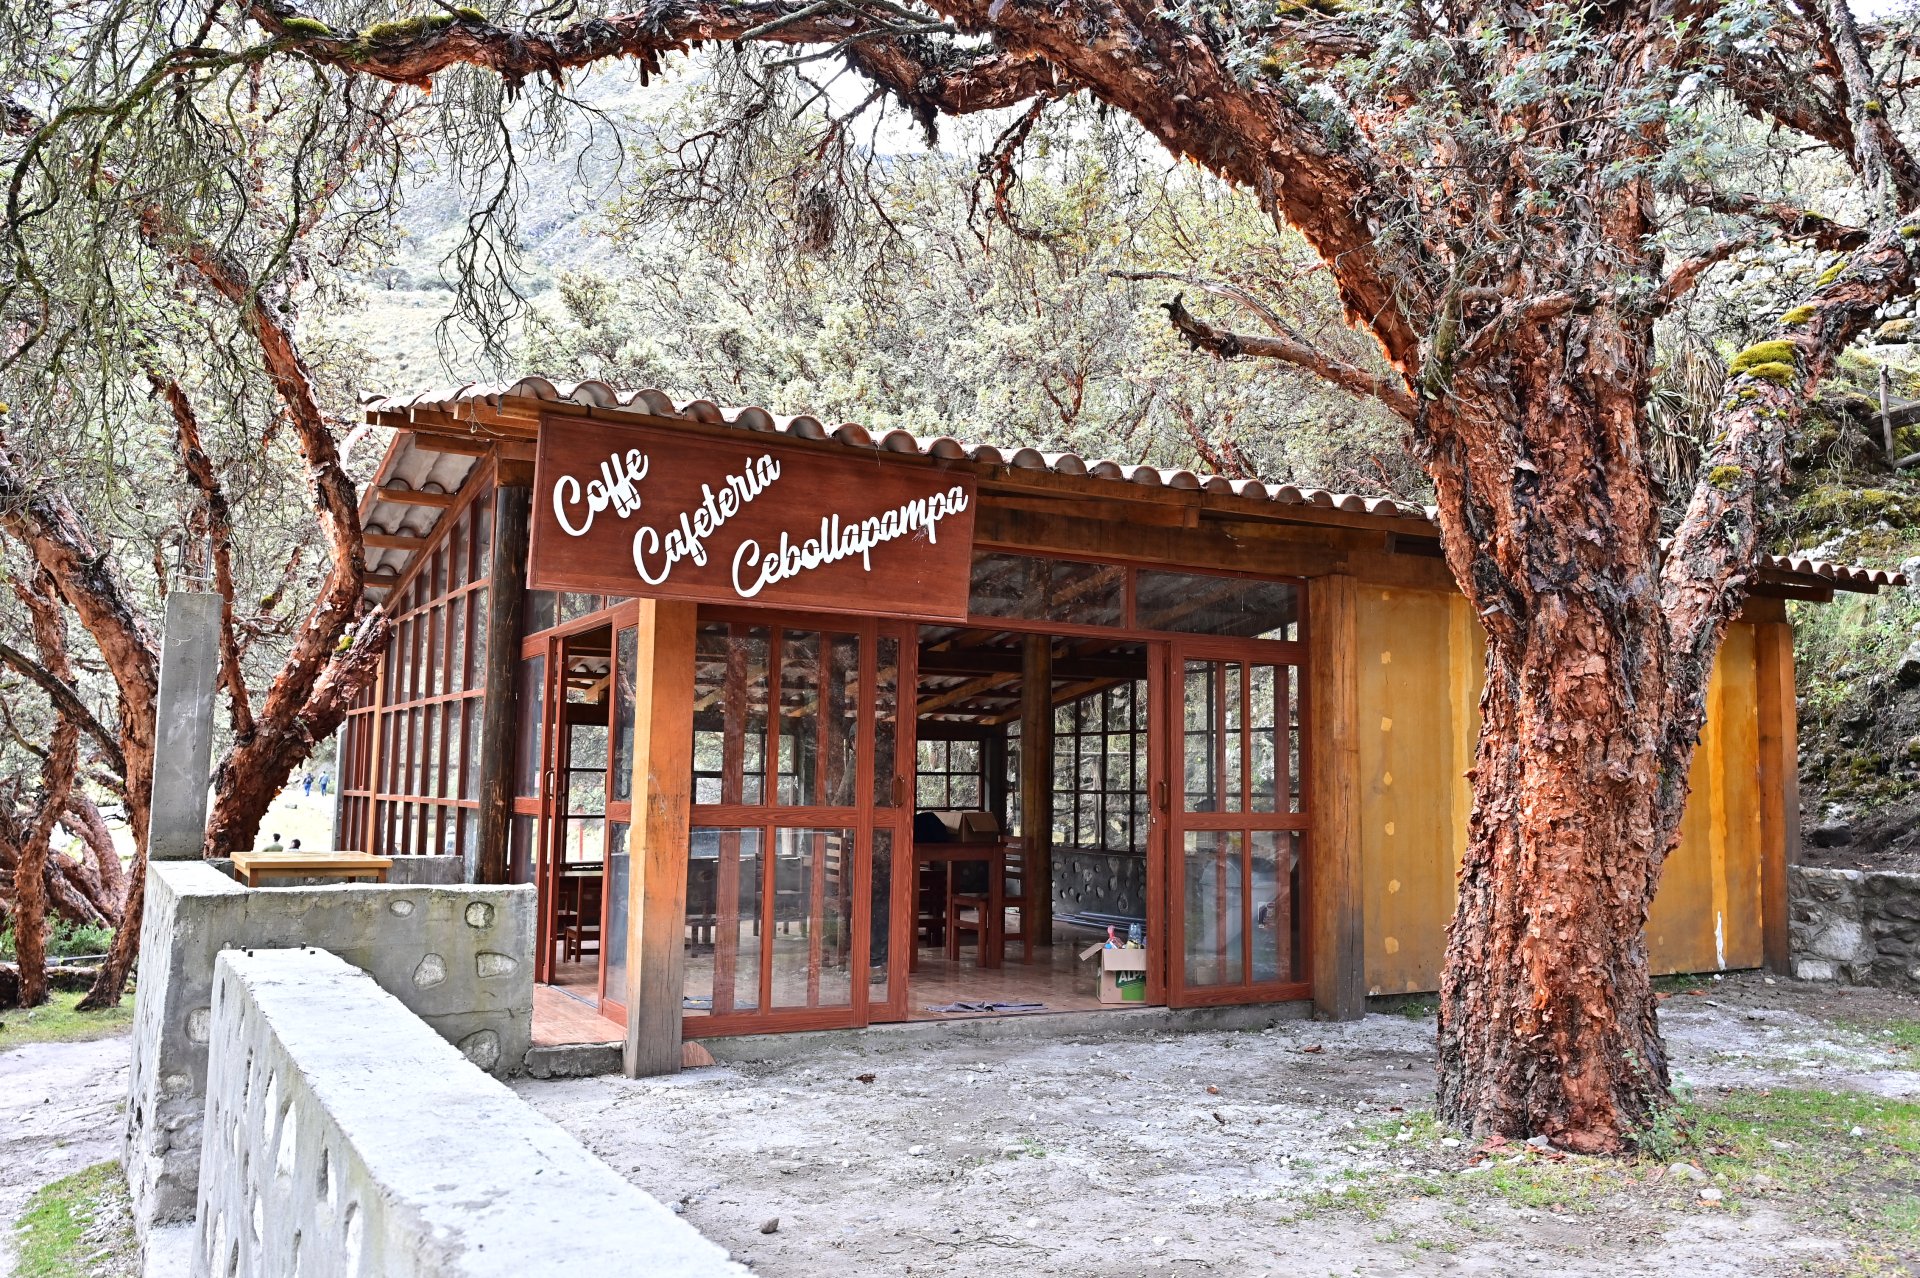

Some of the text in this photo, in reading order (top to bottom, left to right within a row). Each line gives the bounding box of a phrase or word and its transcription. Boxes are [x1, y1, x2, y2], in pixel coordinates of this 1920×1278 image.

[553, 448, 649, 537] Coffe
[632, 453, 781, 585] Cafetería
[732, 485, 969, 598] Cebollapampa
